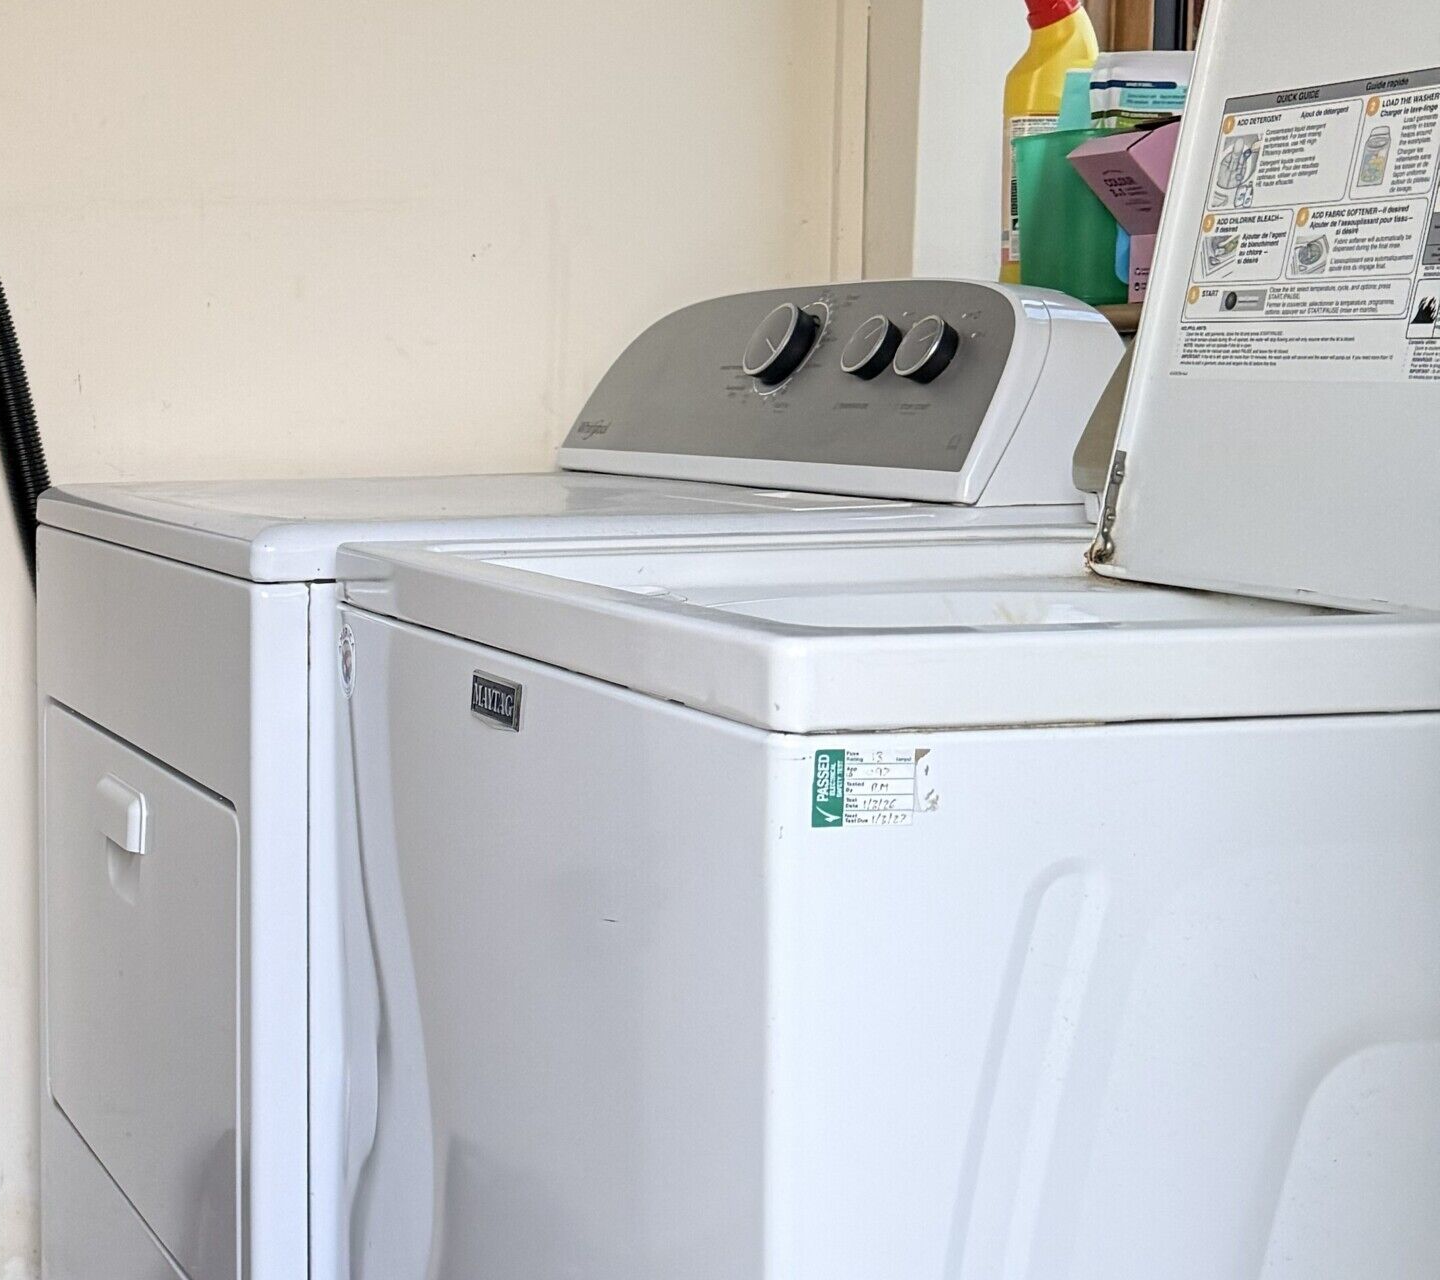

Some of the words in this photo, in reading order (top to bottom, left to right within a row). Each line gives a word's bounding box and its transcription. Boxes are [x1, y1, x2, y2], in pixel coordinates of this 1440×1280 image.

[1366, 81, 1385, 90] Guide
[1276, 93, 1297, 103] QUICK
[1299, 90, 1320, 100] GUIDE
[1382, 99, 1399, 107] LOAD
[1400, 97, 1411, 105] THE
[1380, 108, 1402, 117] Charger
[1250, 114, 1282, 125] DETERGENT
[1325, 209, 1345, 217] FABRIC
[1347, 207, 1377, 216] SOFTENER
[472, 683, 514, 717] MAYTAG
[816, 754, 830, 802] PASSED
